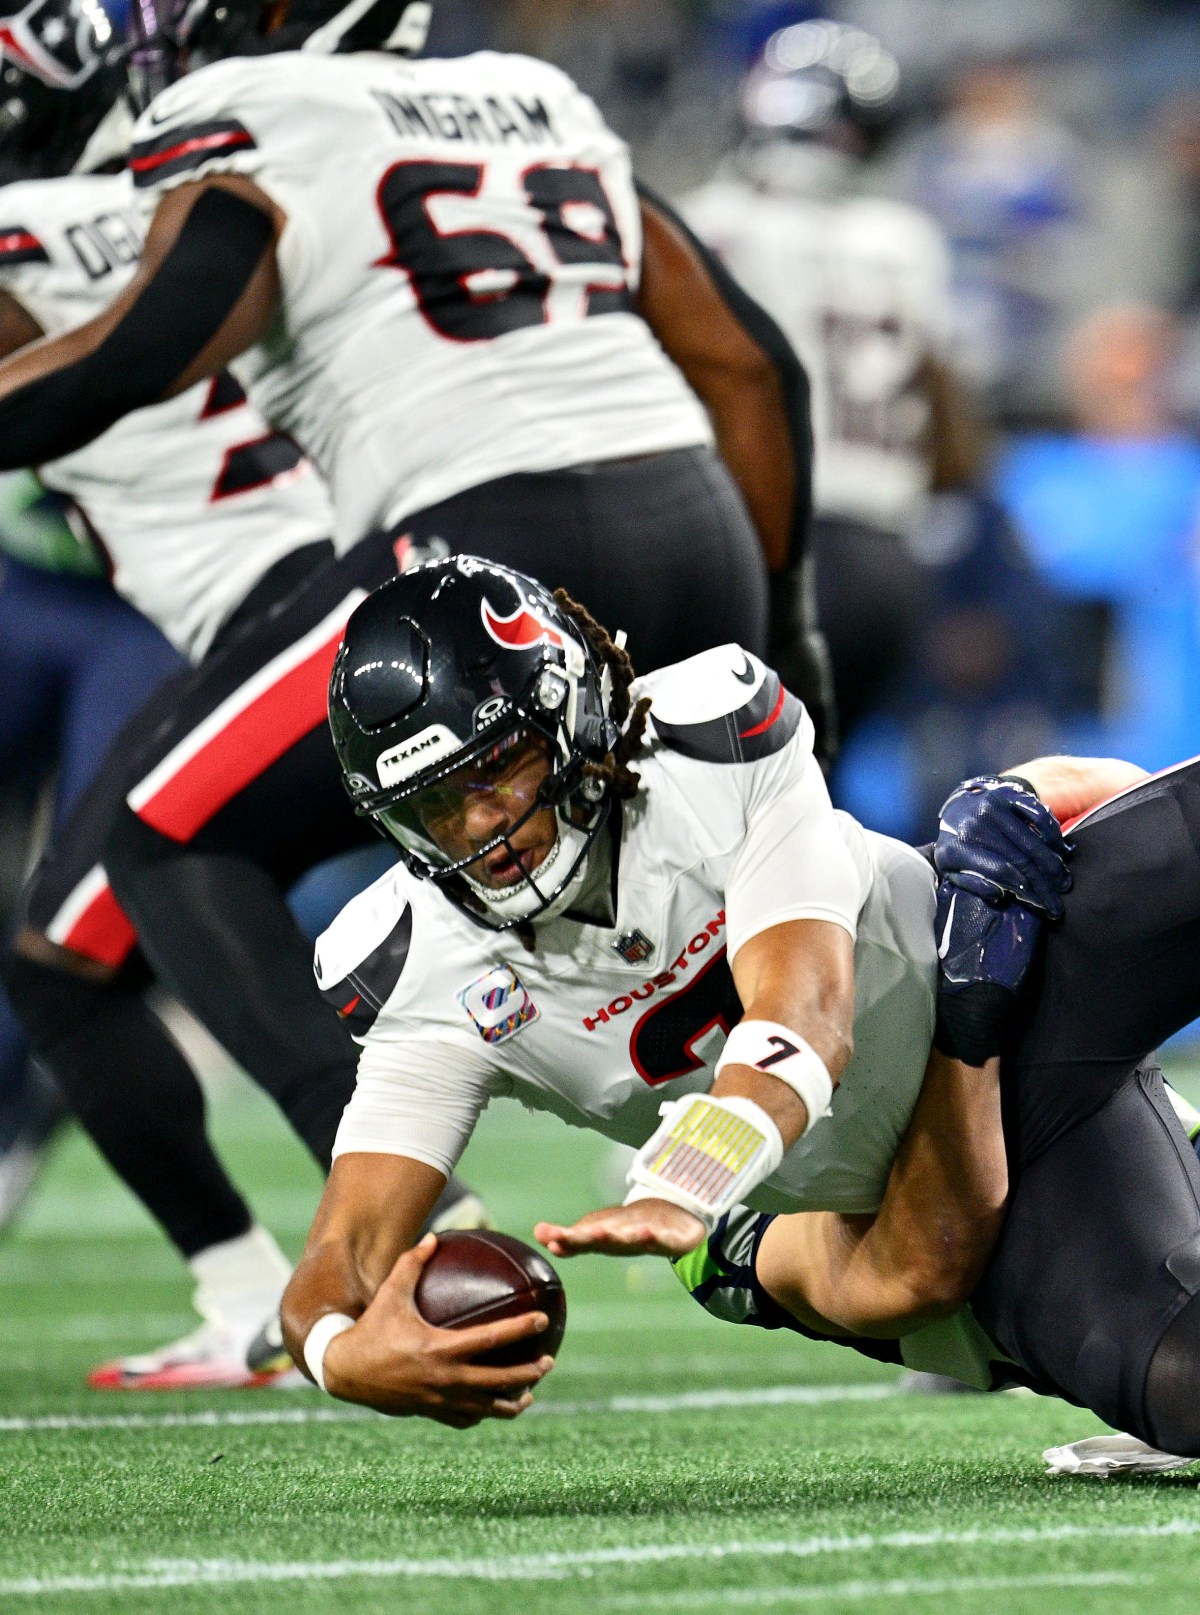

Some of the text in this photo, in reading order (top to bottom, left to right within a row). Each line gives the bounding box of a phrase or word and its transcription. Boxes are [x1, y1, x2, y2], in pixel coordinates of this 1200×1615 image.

[371, 88, 563, 147] INGRAM
[370, 154, 630, 343] 69
[382, 734, 441, 768] TEXANS
[755, 1035, 801, 1072] 7
